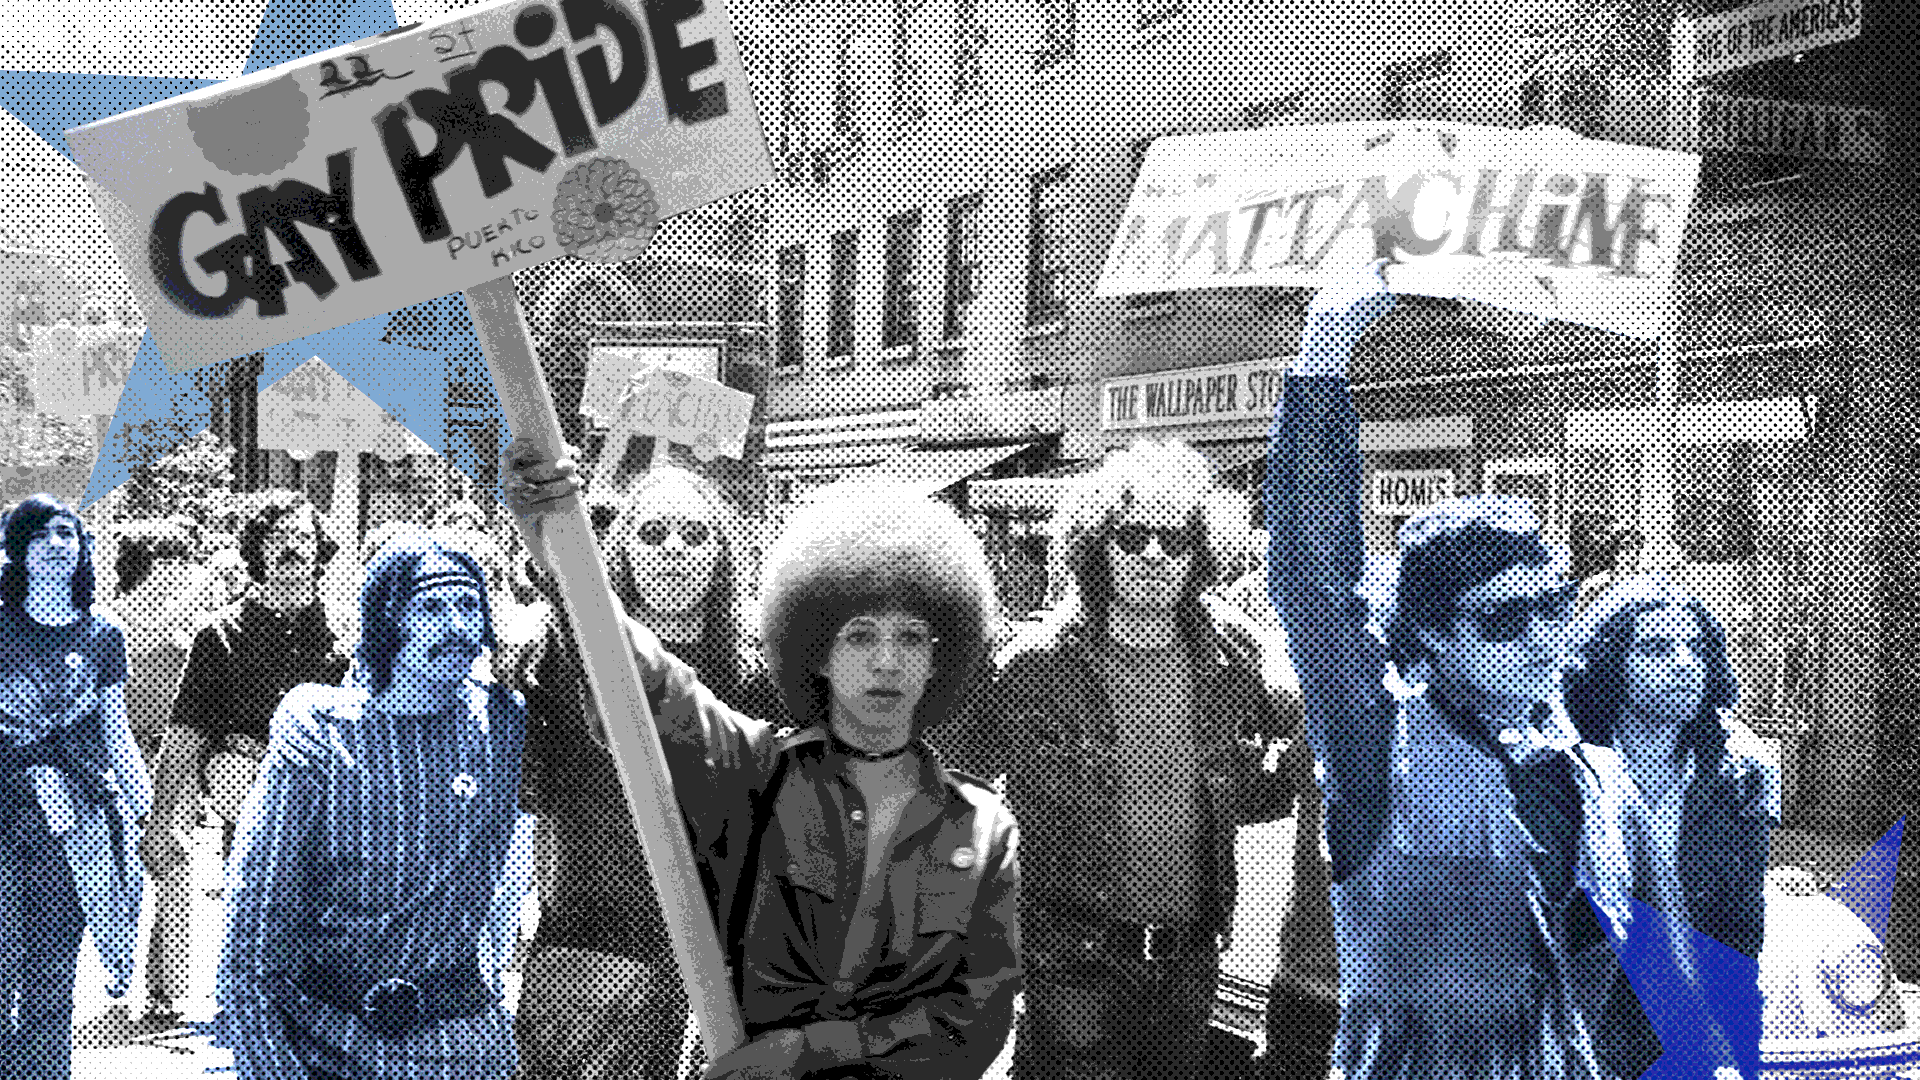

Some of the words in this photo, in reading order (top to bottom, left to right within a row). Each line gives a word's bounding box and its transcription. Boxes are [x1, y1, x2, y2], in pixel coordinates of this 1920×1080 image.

[1749, 15, 1776, 49] THE
[149, 148, 382, 318] GAY
[446, 208, 540, 261] PUERTO
[490, 235, 546, 268] RICO
[1108, 384, 1139, 421] THE
[1145, 372, 1238, 418] WALLPAPER
